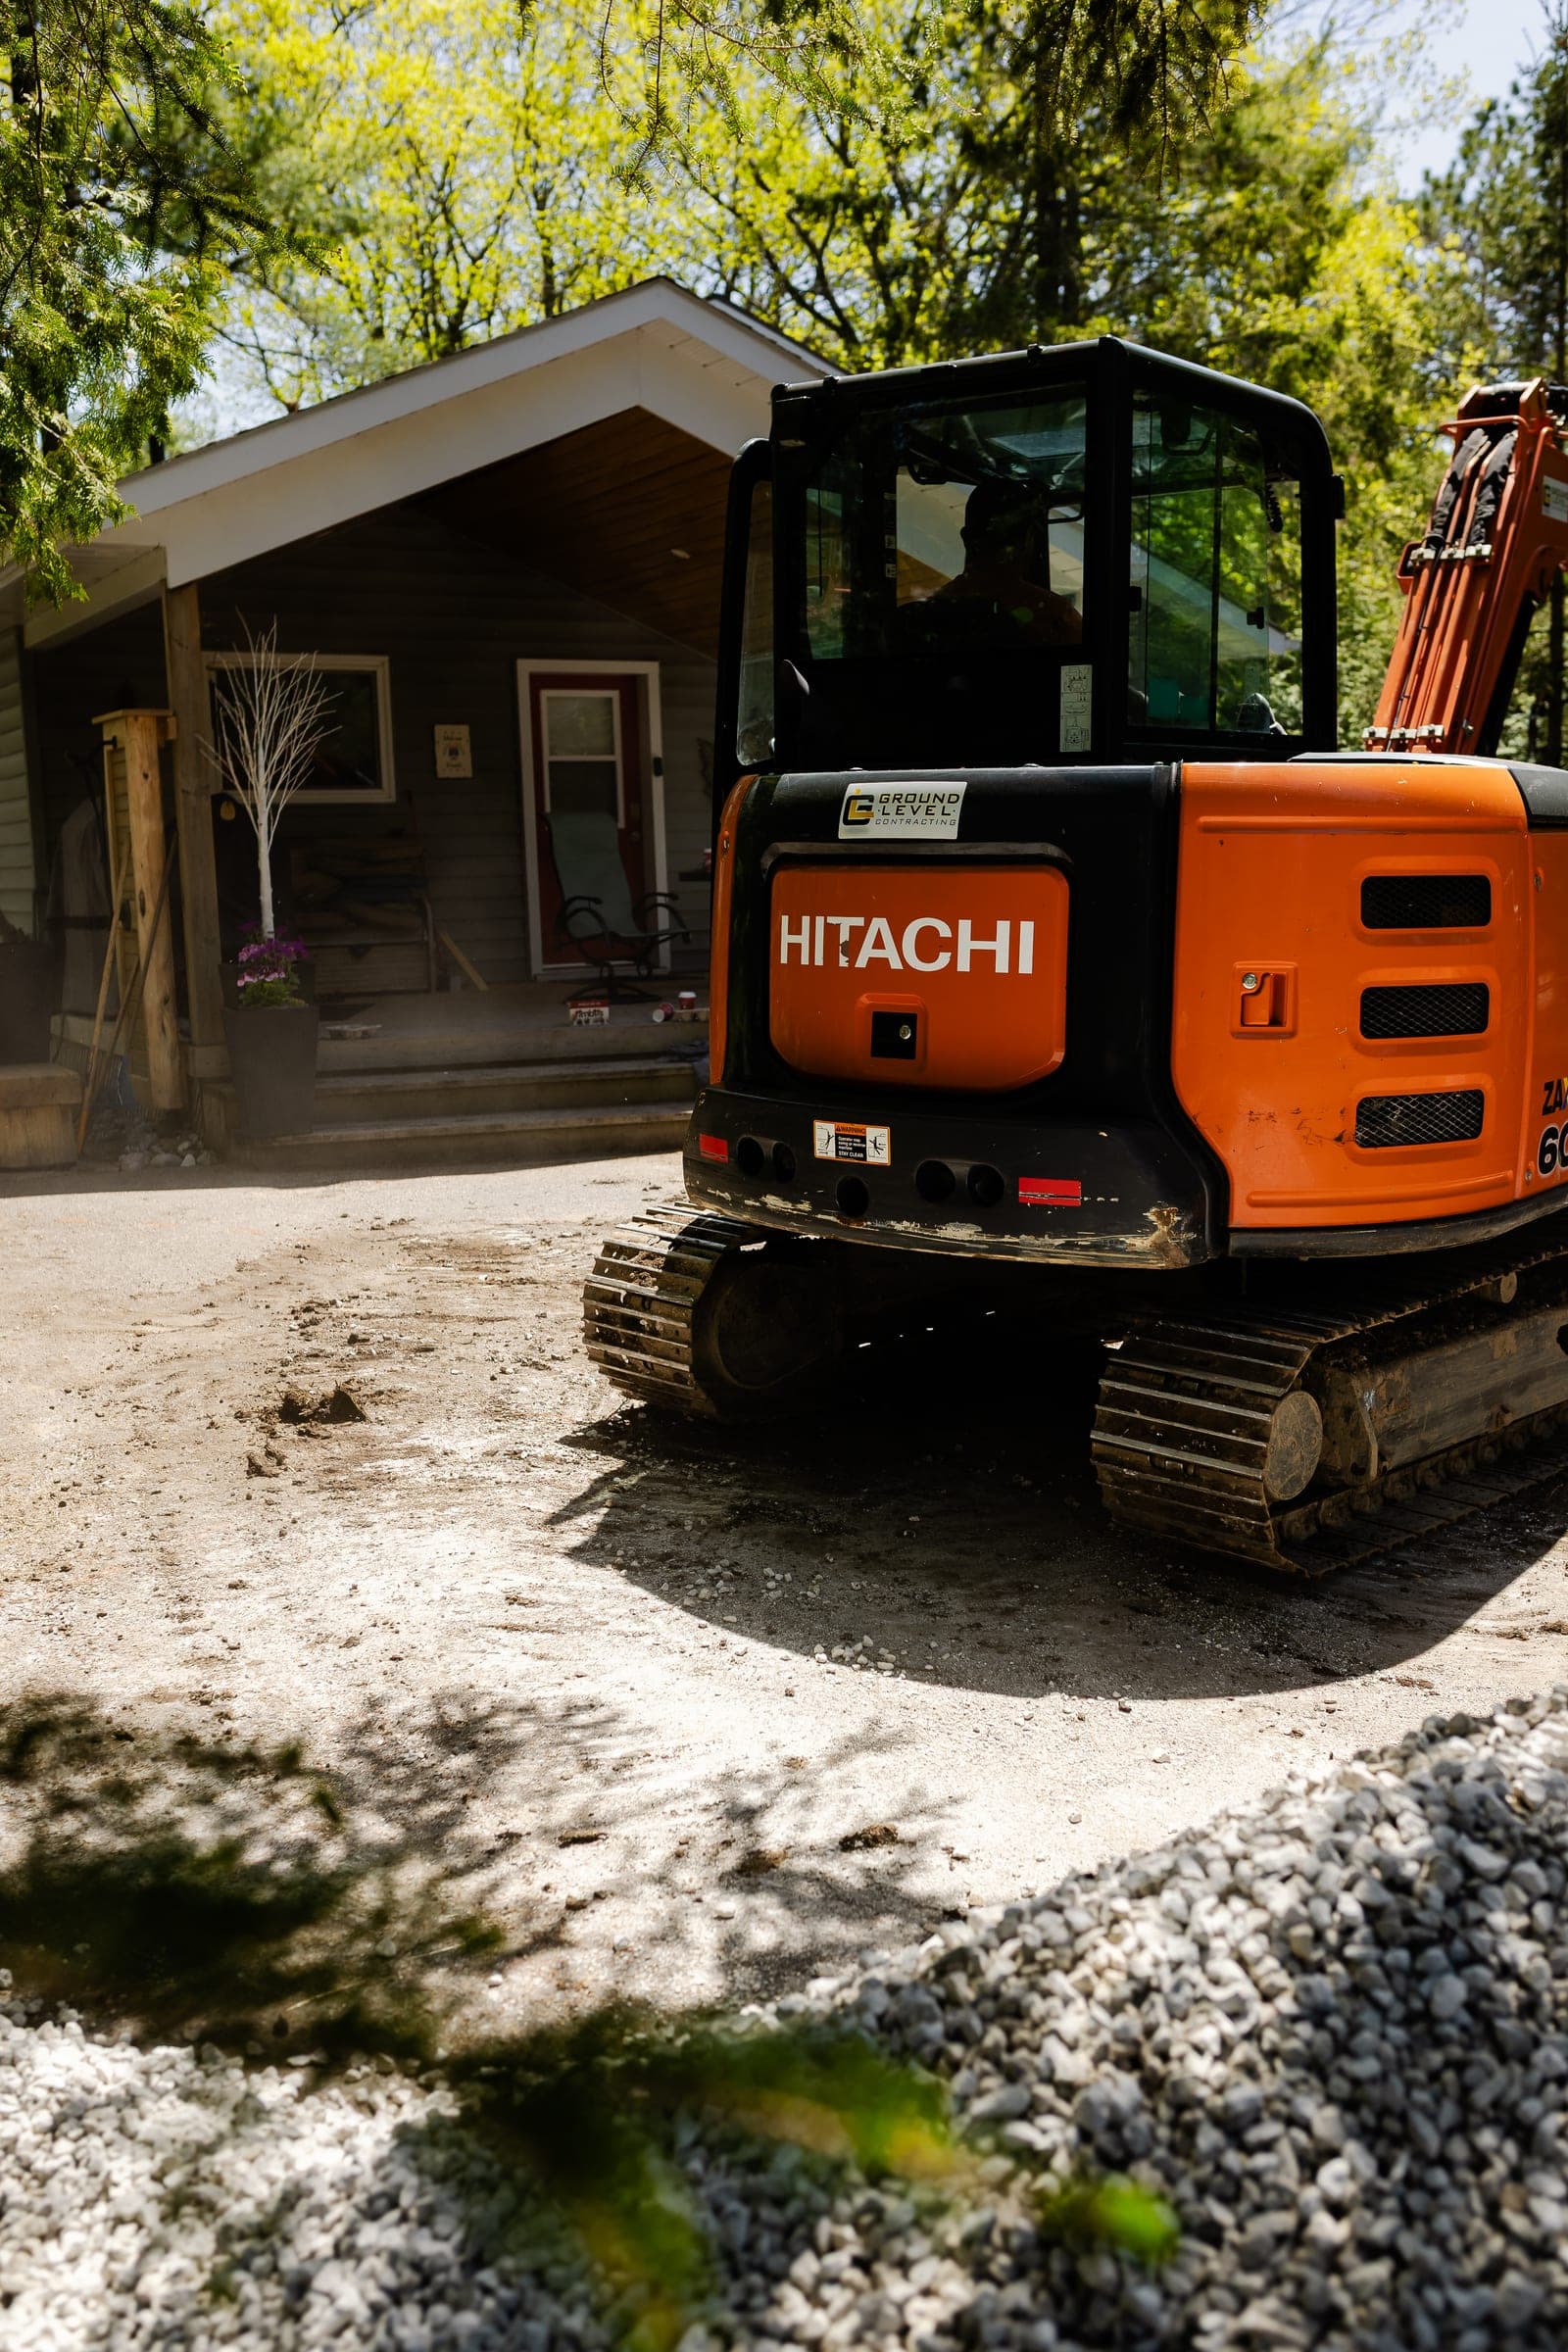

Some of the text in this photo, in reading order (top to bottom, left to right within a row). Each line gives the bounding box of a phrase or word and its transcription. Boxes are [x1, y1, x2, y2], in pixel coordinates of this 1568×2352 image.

[879, 793, 960, 805] GROUND
[882, 805, 952, 816] LEVEL
[780, 914, 1035, 974] HITACHI
